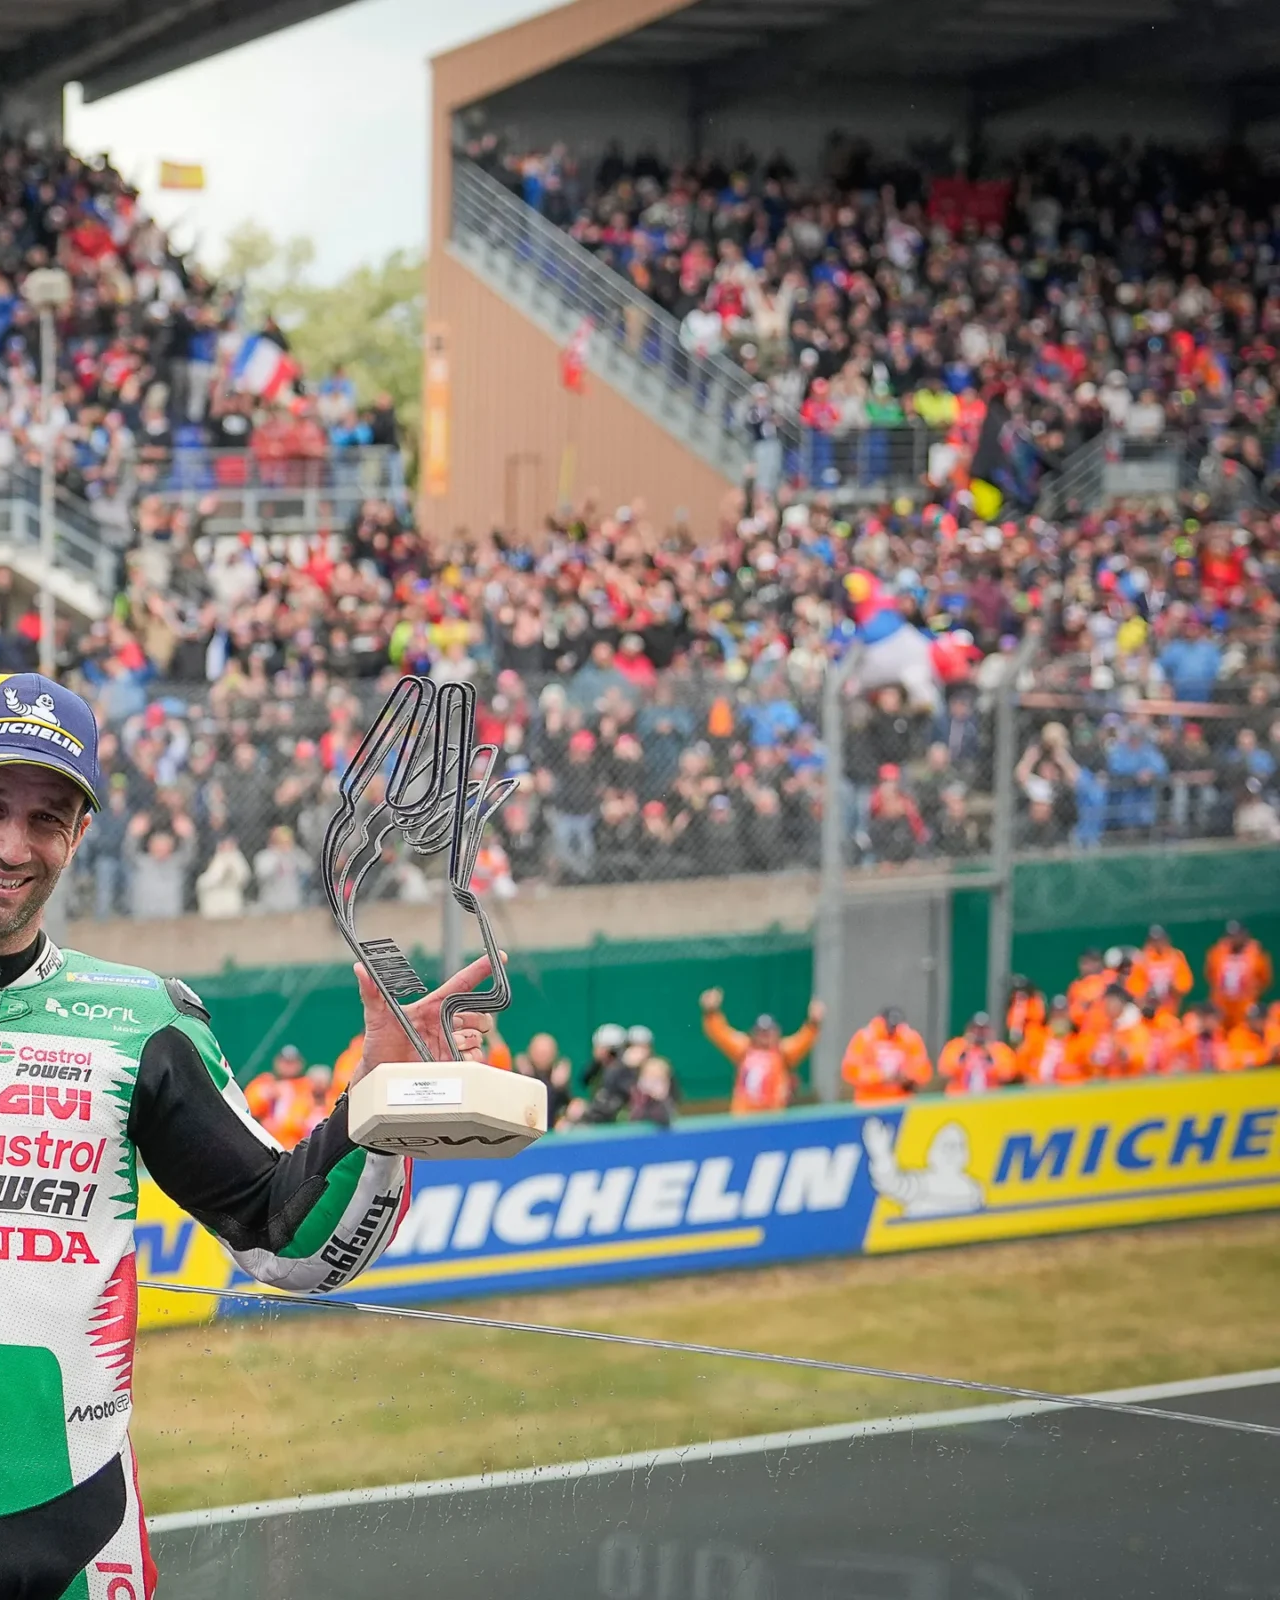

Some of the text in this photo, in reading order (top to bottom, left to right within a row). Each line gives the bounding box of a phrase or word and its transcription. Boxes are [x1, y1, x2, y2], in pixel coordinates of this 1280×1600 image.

[92, 976, 150, 985] MICHELIN
[19, 1046, 92, 1065] Castrol
[16, 1063, 92, 1082] POWER1
[389, 1143, 863, 1257] MICHELIN
[67, 1394, 129, 1422] MotoGP
